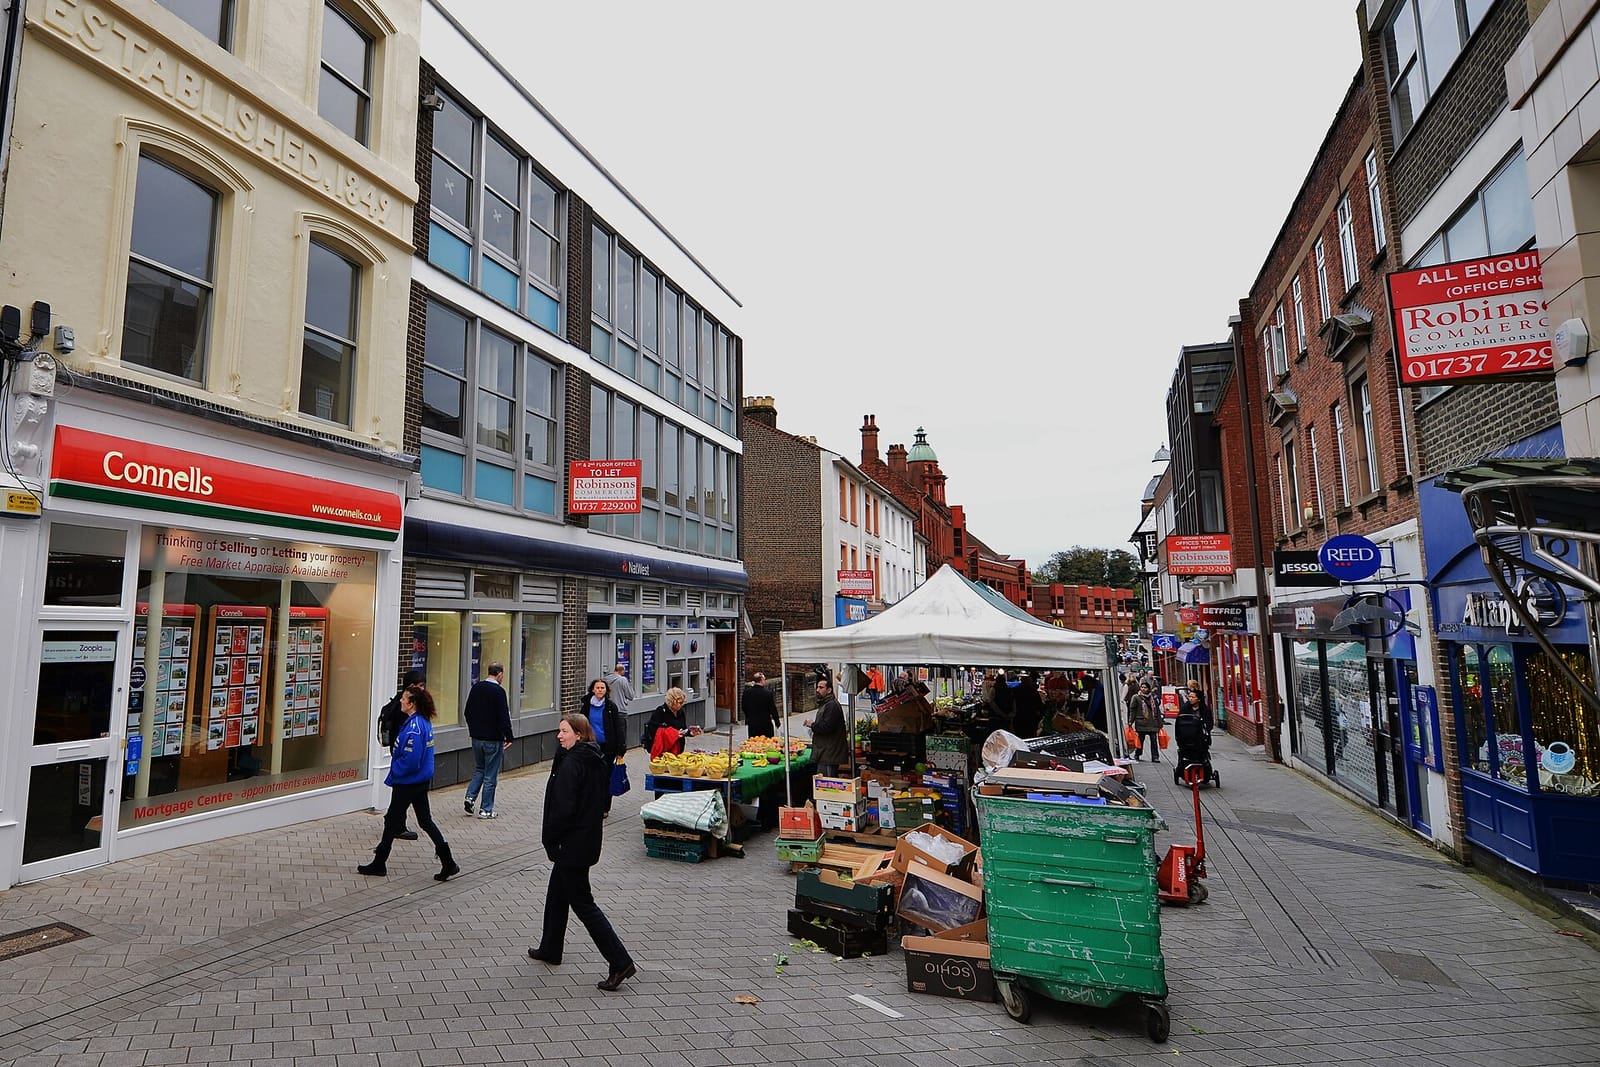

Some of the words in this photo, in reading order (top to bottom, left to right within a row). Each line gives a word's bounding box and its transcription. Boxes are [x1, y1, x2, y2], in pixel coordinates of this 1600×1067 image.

[1418, 268, 1458, 285] ALL
[1408, 317, 1549, 344] COMMERC
[1407, 353, 1488, 379] 01737
[103, 450, 214, 496] Connells
[590, 469, 602, 477] TO
[604, 468, 621, 477] LET
[575, 478, 636, 489] Robinsons
[311, 503, 382, 523] www.connells.co.uk
[572, 502, 598, 511] 01737
[601, 501, 637, 511] 229200
[156, 533, 203, 552] Thinking
[206, 539, 218, 551] of
[219, 540, 258, 557] Selling
[260, 547, 270, 556] or
[272, 546, 308, 562] Letting
[309, 551, 329, 563] your
[329, 553, 366, 568] property?
[1171, 552, 1229, 561] Robinsons
[1326, 547, 1374, 561] REED
[179, 554, 203, 568] Free
[205, 556, 242, 571] Market
[243, 560, 289, 575] Appraisals
[290, 564, 329, 578] Available
[330, 569, 349, 579] Here
[628, 561, 650, 577] NatWest
[1197, 565, 1232, 573] 229200
[220, 608, 243, 618] Connells
[1202, 607, 1242, 615] BETFRED
[1462, 588, 1539, 635] Atlans
[134, 800, 194, 820] Mortgage
[197, 792, 233, 807] Centre
[240, 778, 301, 799] appointments
[301, 770, 337, 786] available
[338, 766, 360, 780] today
[924, 962, 971, 978] SCHIO
